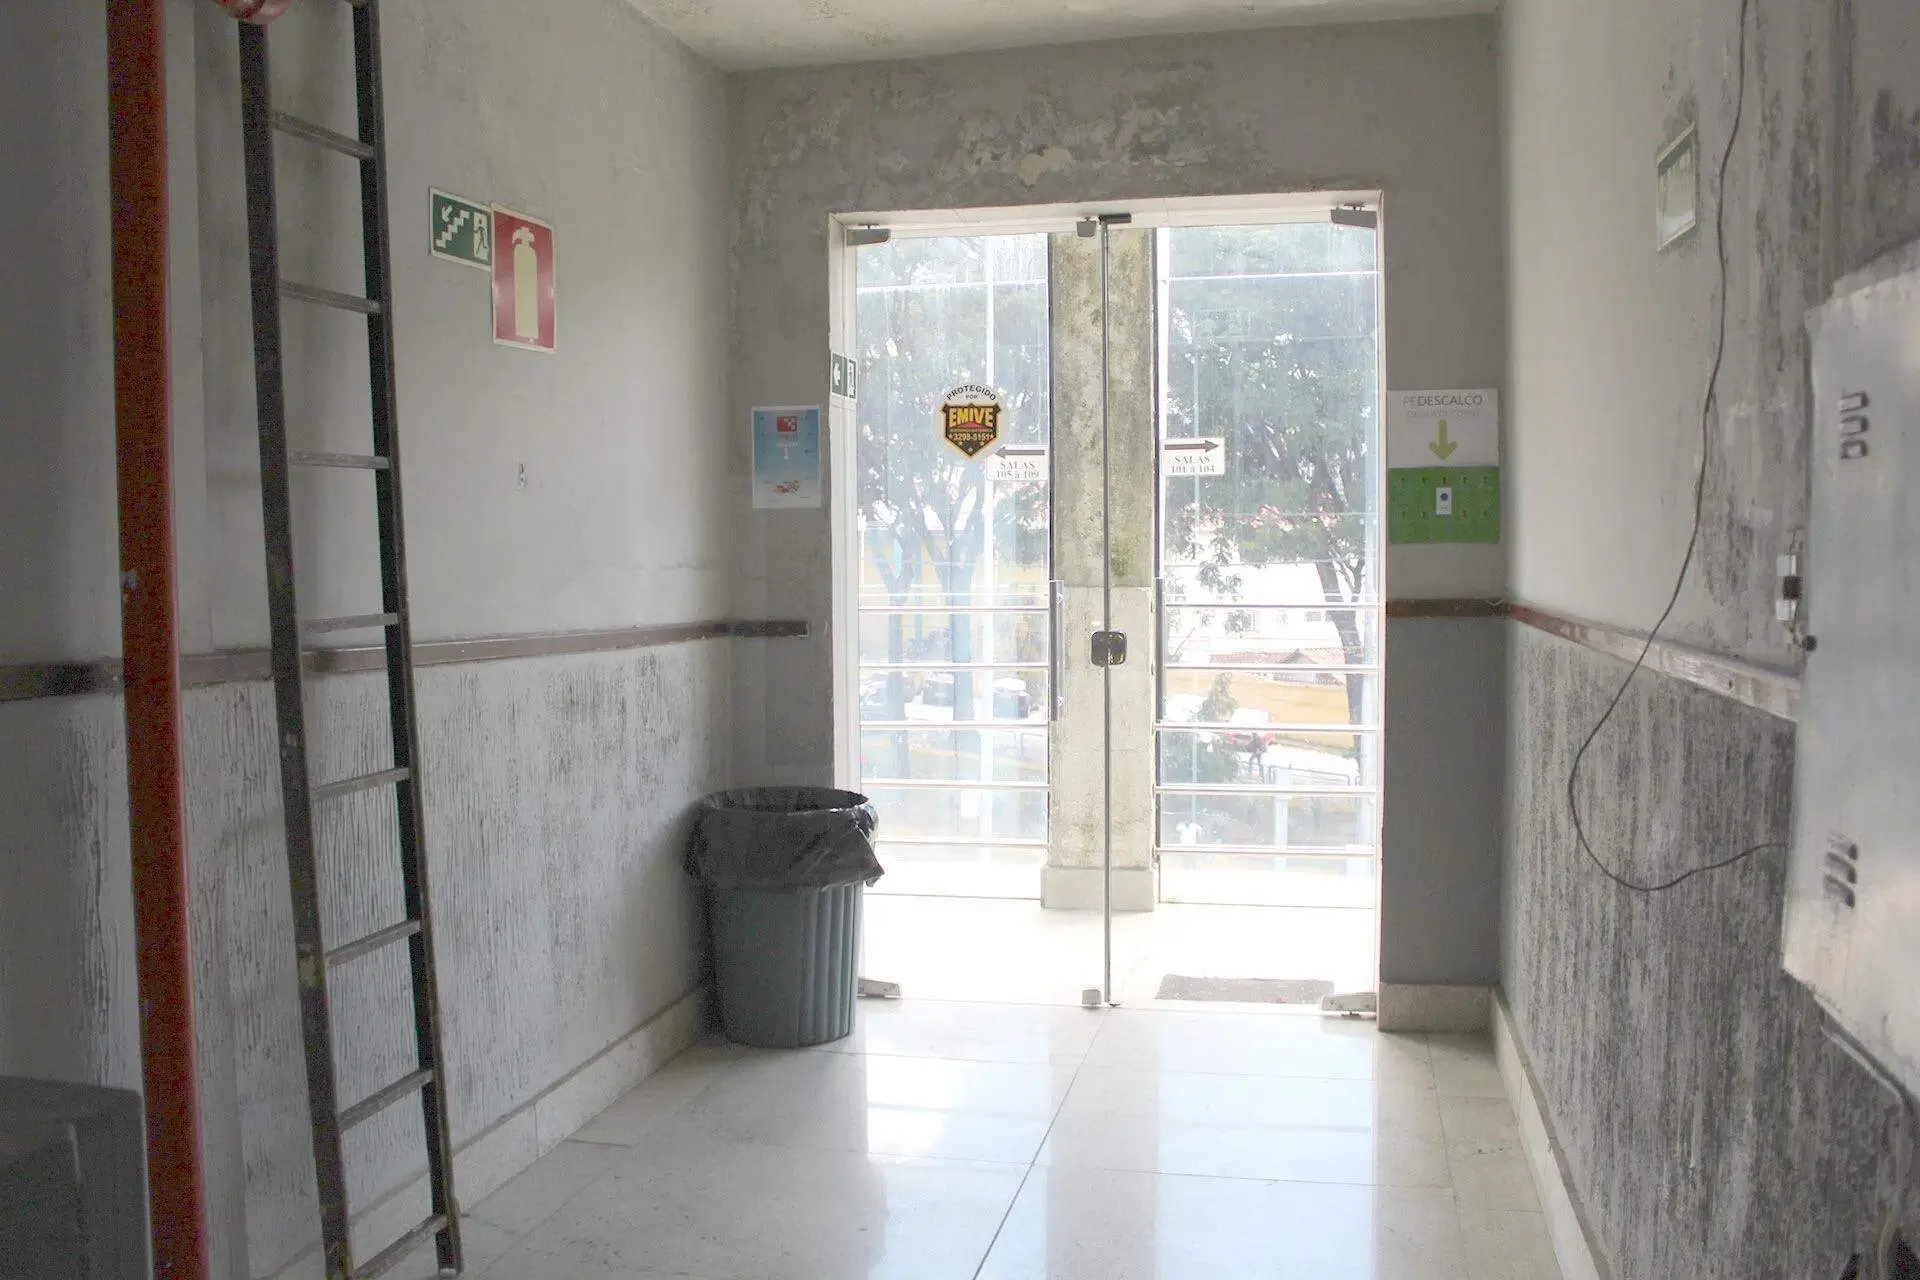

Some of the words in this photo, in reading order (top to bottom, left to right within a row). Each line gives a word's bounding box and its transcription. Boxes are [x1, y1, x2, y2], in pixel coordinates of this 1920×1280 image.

[946, 385, 996, 401] PROTEGIDO
[949, 408, 994, 428] EMIVE
[1174, 455, 1210, 464] SALAS
[1000, 461, 1035, 470] SALAS
[1171, 465, 1186, 474] 101
[996, 470, 1012, 479] 105
